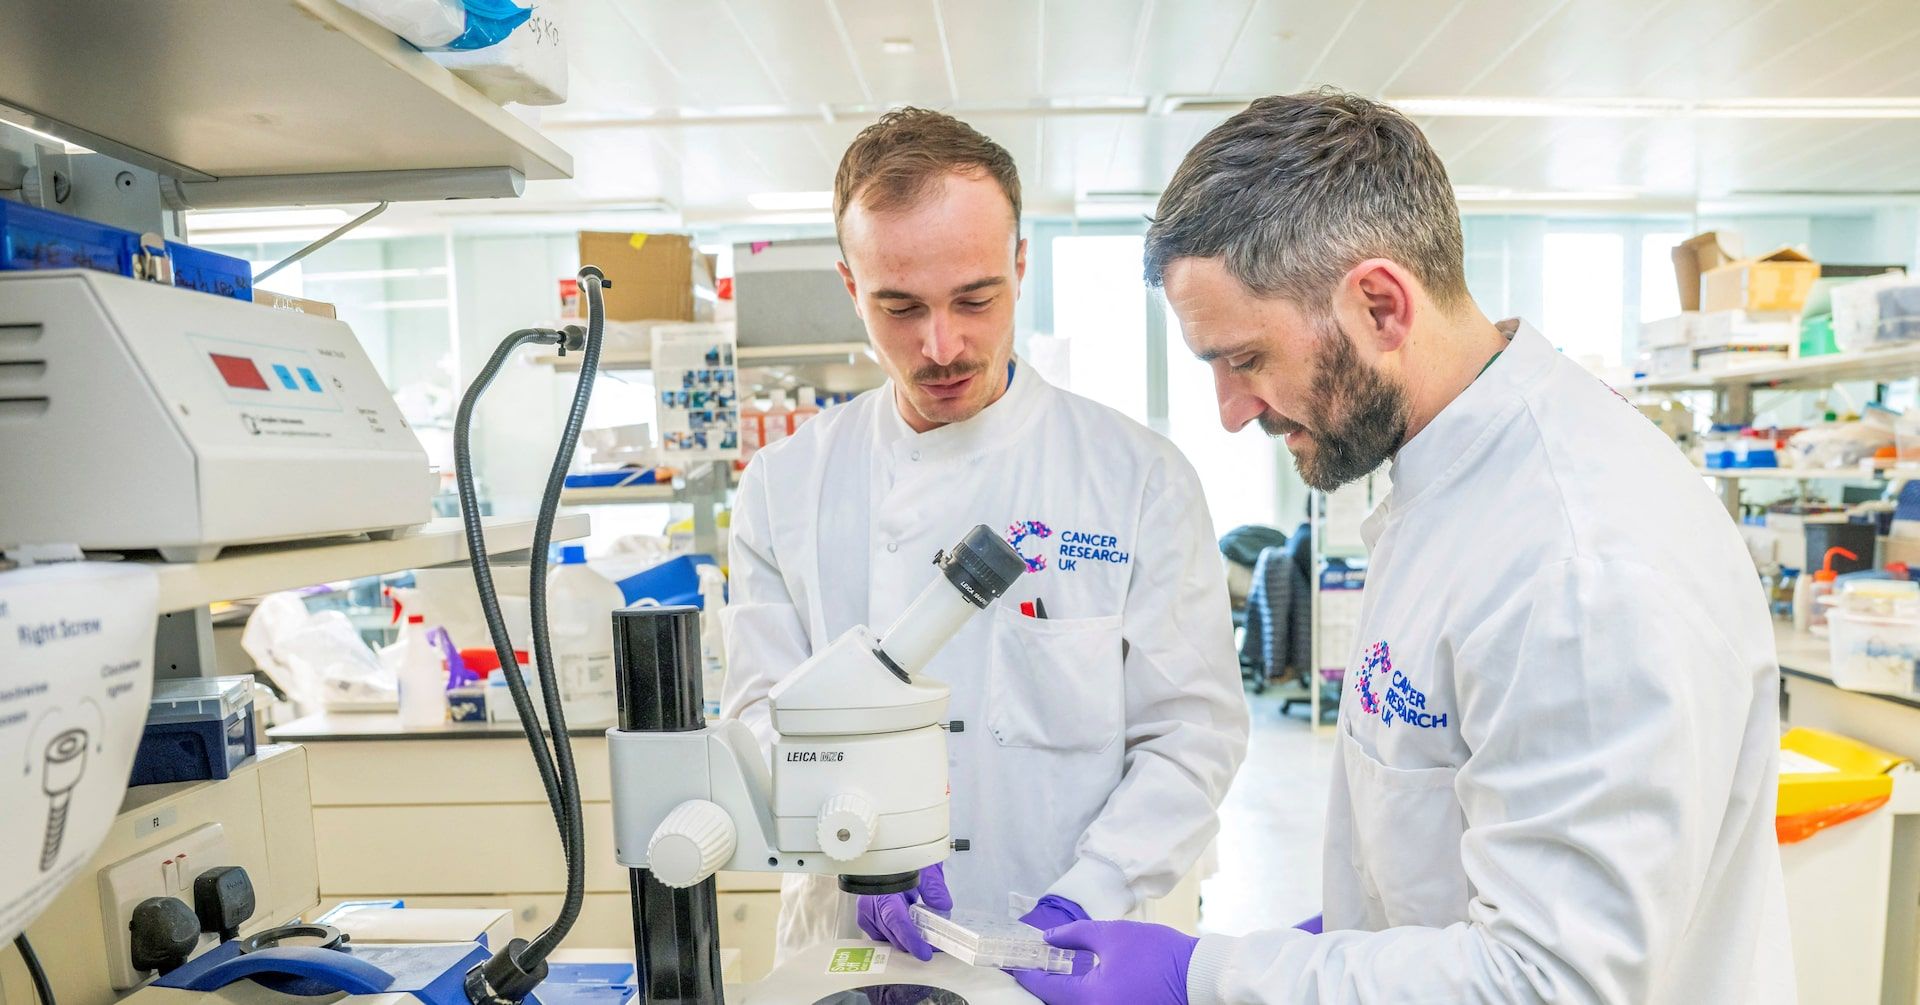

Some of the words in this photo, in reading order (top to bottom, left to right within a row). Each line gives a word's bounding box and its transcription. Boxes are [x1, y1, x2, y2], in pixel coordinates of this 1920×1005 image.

[1061, 531, 1117, 548] CANCER
[1060, 544, 1129, 563] RESEARCH
[1058, 558, 1076, 571] UK
[18, 624, 56, 646] Right
[60, 618, 101, 638] Screw
[1392, 670, 1426, 710] CANER
[1381, 704, 1394, 728] UK
[1385, 687, 1447, 728] RESARCH
[786, 751, 817, 762] LEICA
